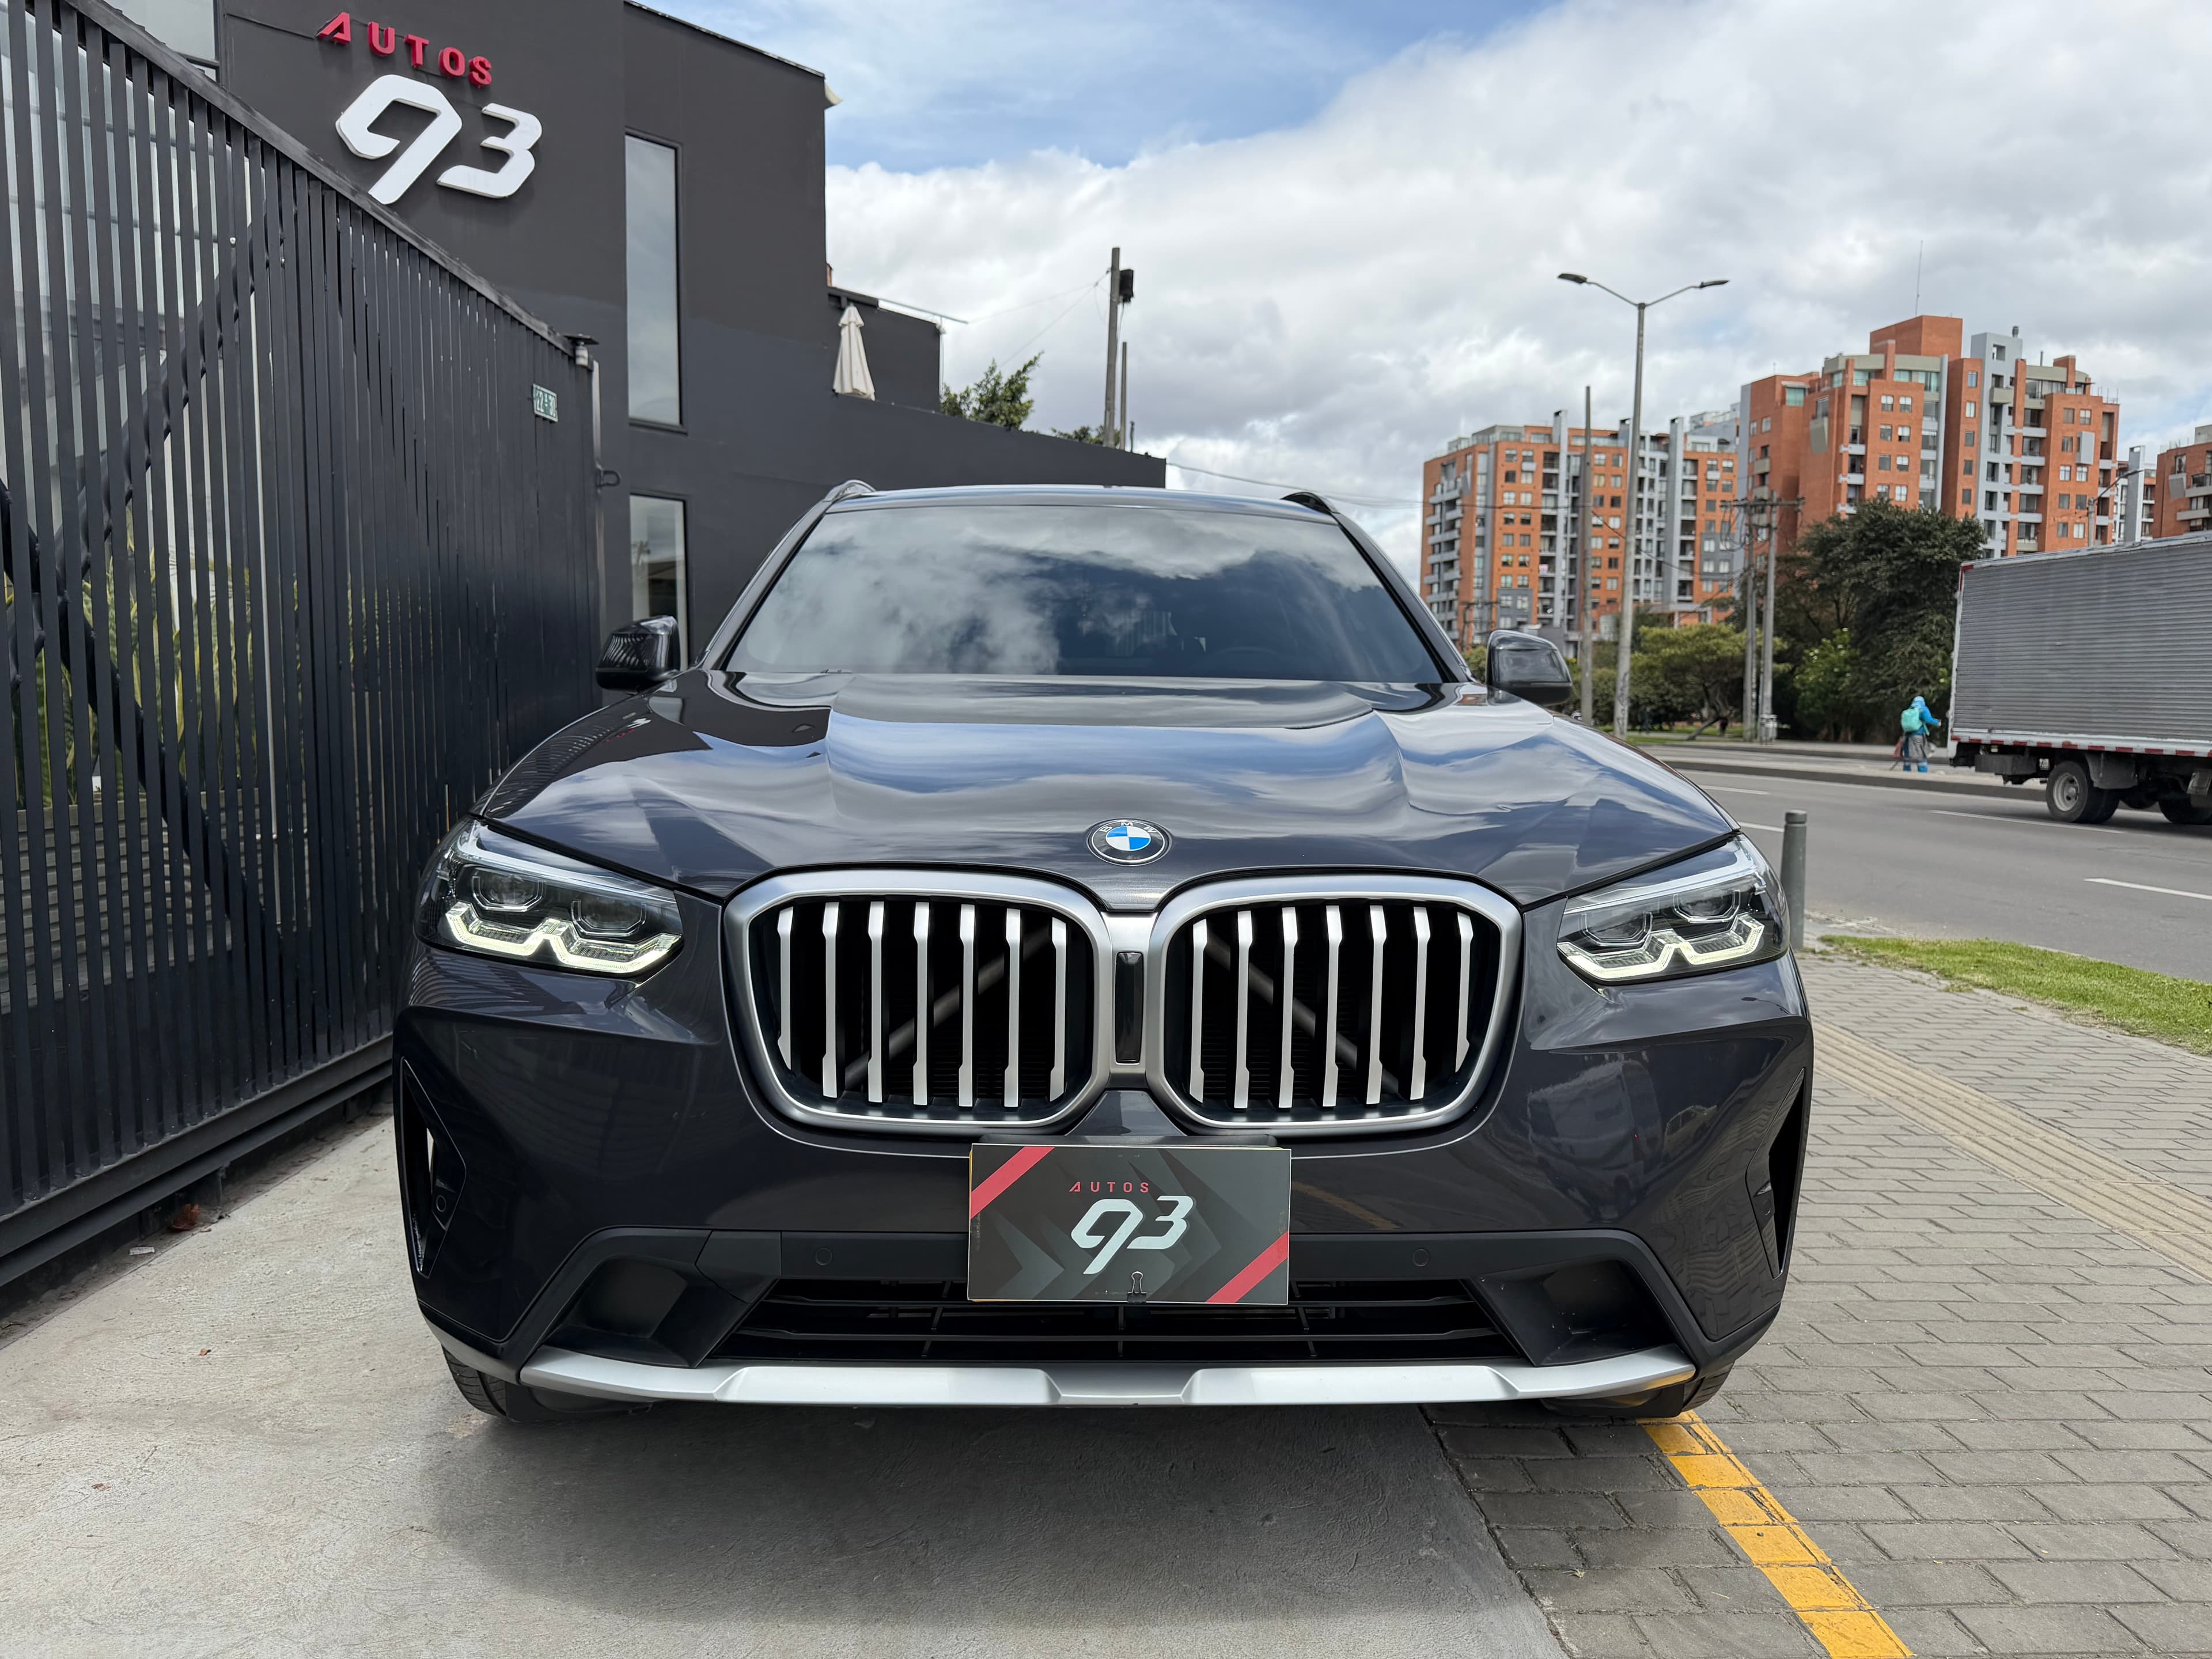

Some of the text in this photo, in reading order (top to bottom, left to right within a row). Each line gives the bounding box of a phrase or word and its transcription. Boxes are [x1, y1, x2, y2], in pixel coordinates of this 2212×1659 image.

[316, 12, 492, 86] AUTOS
[335, 74, 542, 204] 93
[1099, 821, 1157, 833] BMW
[1069, 1181, 1149, 1193] AUTOS
[1071, 1195, 1194, 1275] 93
